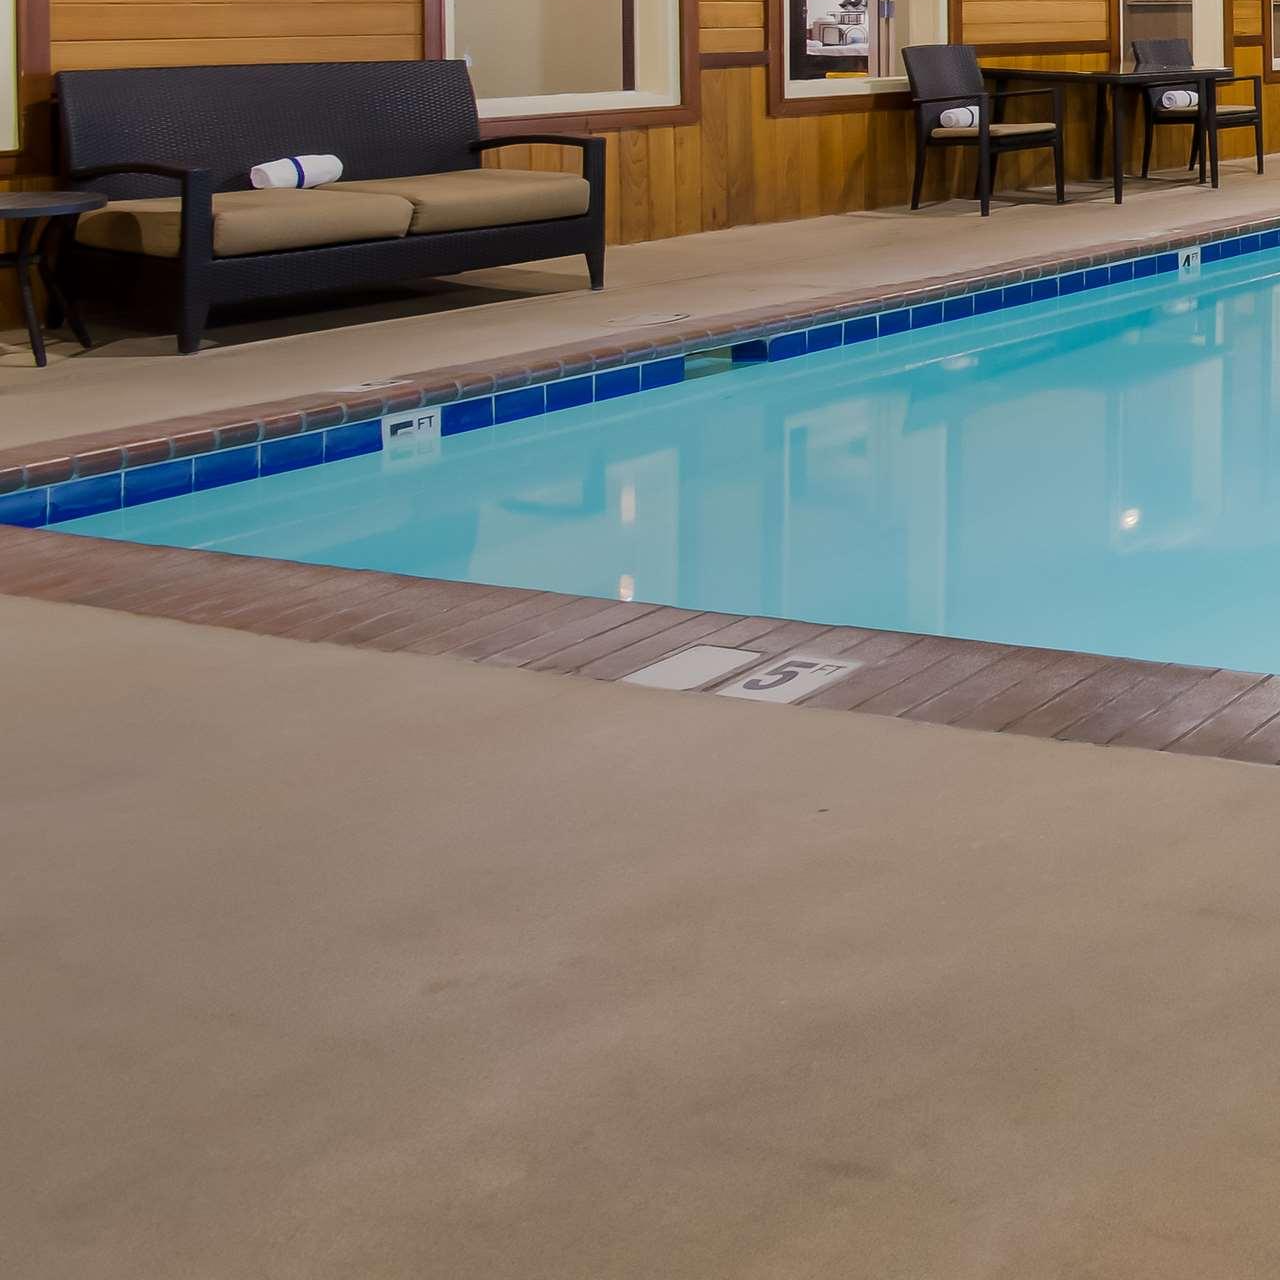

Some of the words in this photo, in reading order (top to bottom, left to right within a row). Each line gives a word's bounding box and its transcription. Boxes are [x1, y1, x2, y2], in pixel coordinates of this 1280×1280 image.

[417, 415, 434, 430] FT
[742, 660, 820, 690] 5
[810, 664, 847, 676] FT
